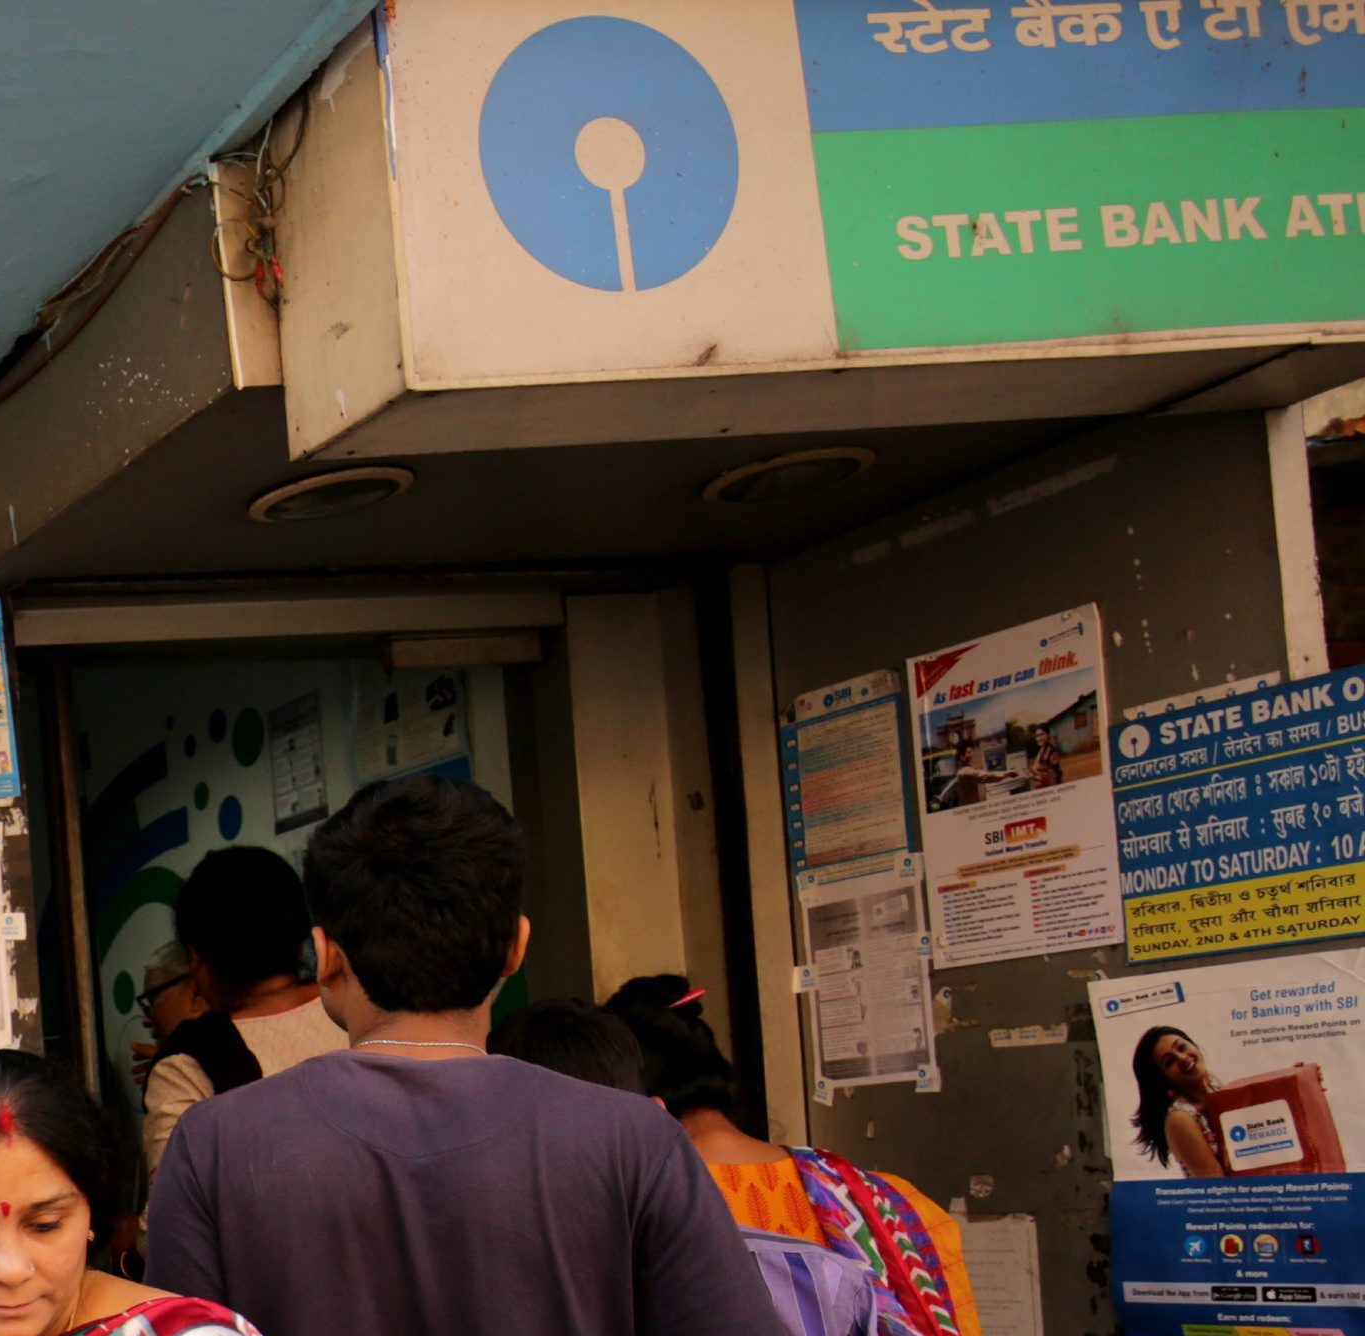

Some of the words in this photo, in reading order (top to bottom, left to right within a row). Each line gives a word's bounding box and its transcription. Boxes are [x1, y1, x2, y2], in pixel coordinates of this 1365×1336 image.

[896, 207, 1083, 261] STATE
[1100, 197, 1268, 248] BANK
[934, 692, 947, 705] As
[949, 680, 975, 702] fast
[977, 681, 990, 693] as
[992, 674, 1011, 691] you
[1014, 668, 1036, 683] can
[1160, 705, 1243, 745] STATE
[1251, 683, 1335, 724] BANK
[1342, 677, 1365, 701] O
[984, 831, 1004, 846] SBI
[1121, 862, 1188, 895] MONDAY
[1191, 858, 1214, 883] TO
[1219, 841, 1310, 879] SATURDAY
[1331, 834, 1354, 860] 10
[1133, 938, 1192, 954] SUNDAY,
[1196, 934, 1224, 946] 2ND
[1229, 932, 1239, 941] &
[1243, 928, 1271, 939] 4TH
[1276, 915, 1361, 935] SATURDAY
[1250, 988, 1273, 1001] Get
[1275, 981, 1336, 999] rewarded
[1231, 1007, 1248, 1021] for
[1252, 1003, 1301, 1019] Banking
[1305, 999, 1333, 1013] with
[1336, 995, 1358, 1009] SBI
[1230, 1028, 1248, 1037] Earn
[1250, 1025, 1285, 1035] attractive
[1287, 1021, 1319, 1032] Reward
[1321, 1018, 1347, 1029] Points
[1350, 1018, 1361, 1026] on
[1242, 1037, 1260, 1047] your
[1261, 1034, 1294, 1045] banking
[1296, 1029, 1349, 1041] transactions.
[1286, 1183, 1319, 1192] Reward
